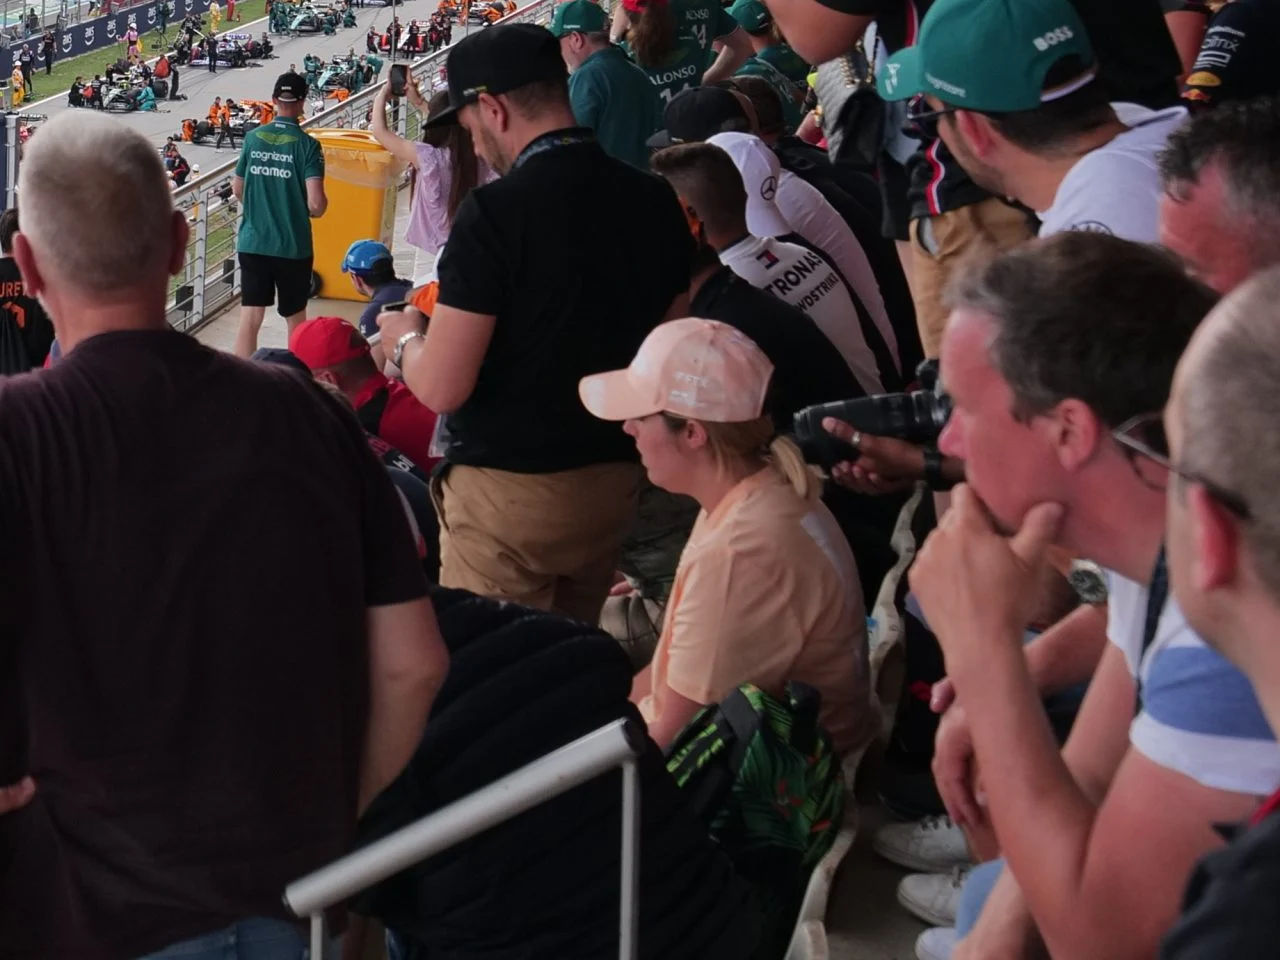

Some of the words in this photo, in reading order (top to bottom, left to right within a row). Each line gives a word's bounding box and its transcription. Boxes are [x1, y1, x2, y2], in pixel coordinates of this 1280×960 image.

[1032, 25, 1074, 52] BOSS
[250, 149, 293, 164] cognizant
[250, 165, 292, 179] aramco
